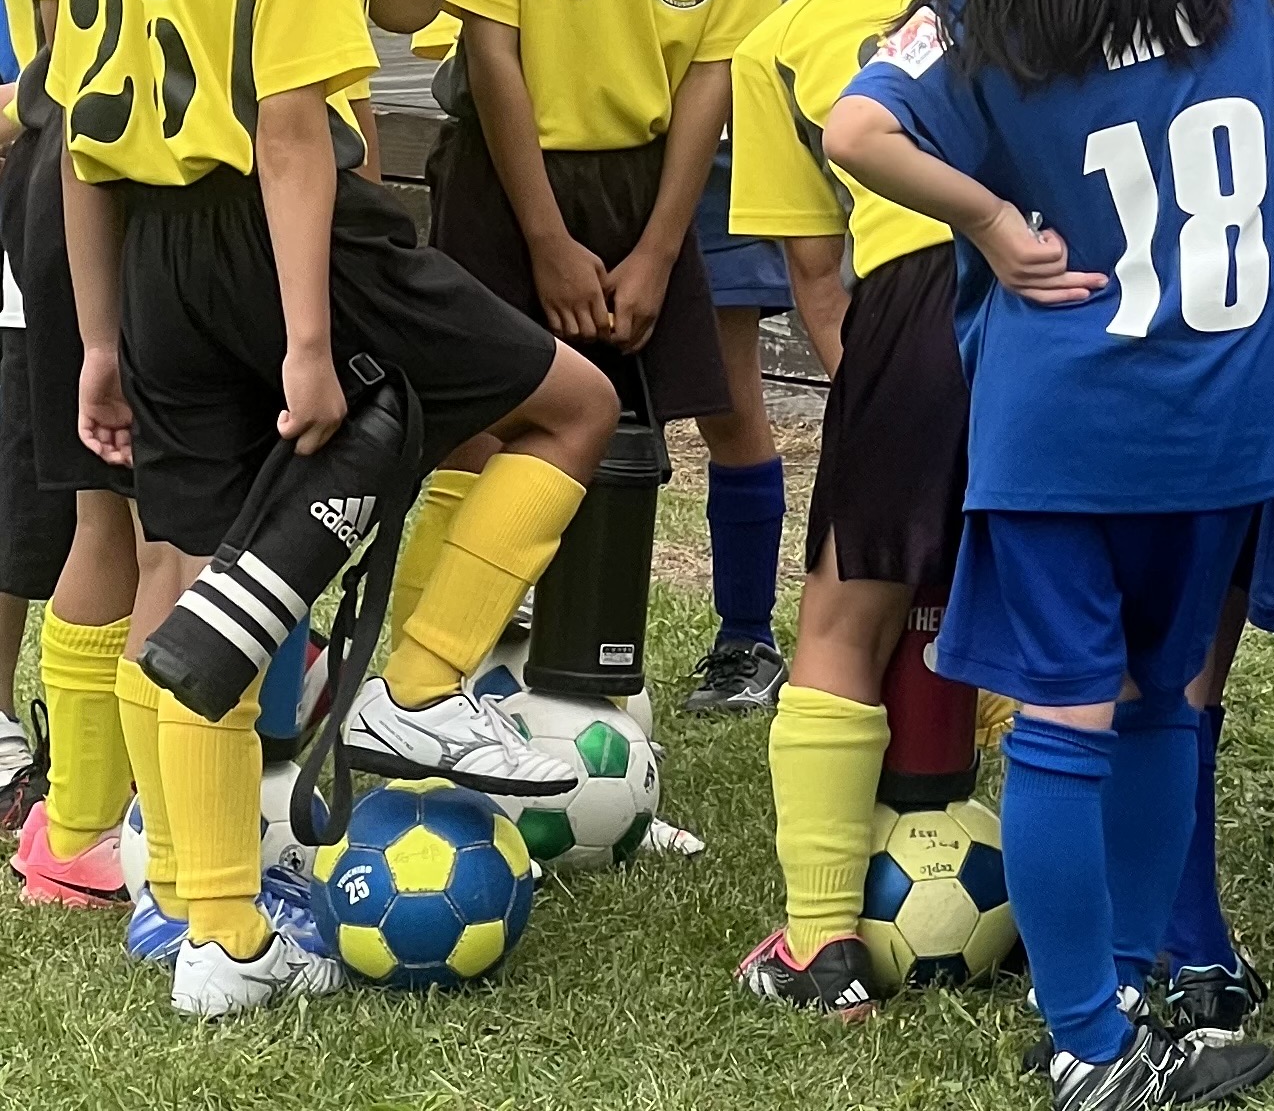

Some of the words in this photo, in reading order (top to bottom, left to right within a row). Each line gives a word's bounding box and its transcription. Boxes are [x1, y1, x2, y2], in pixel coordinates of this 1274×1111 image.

[1082, 96, 1270, 338] 18
[908, 607, 944, 631] THE
[345, 875, 370, 905] 25
